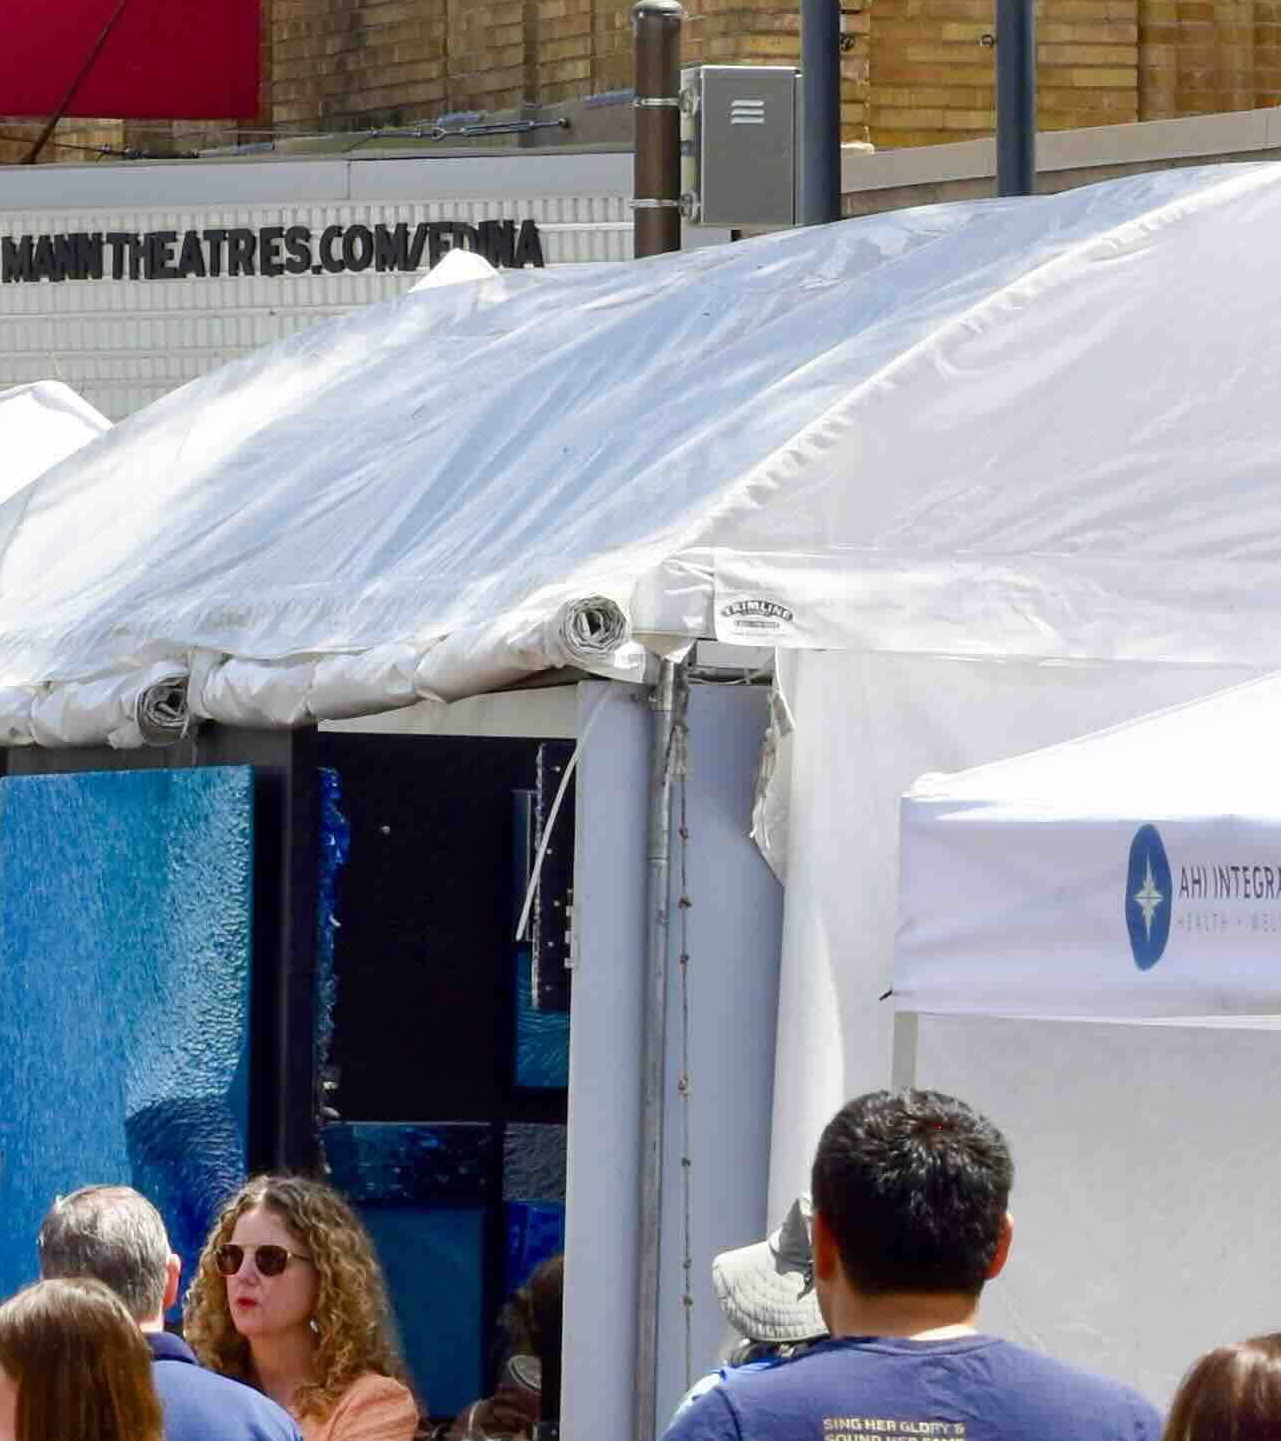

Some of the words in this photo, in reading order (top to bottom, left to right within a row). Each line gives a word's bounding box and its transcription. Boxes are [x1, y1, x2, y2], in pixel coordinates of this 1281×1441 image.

[1179, 865, 1207, 899] AHI
[823, 1417, 861, 1431] SING
[865, 1419, 896, 1432] HER
[900, 1421, 951, 1435] GLORY
